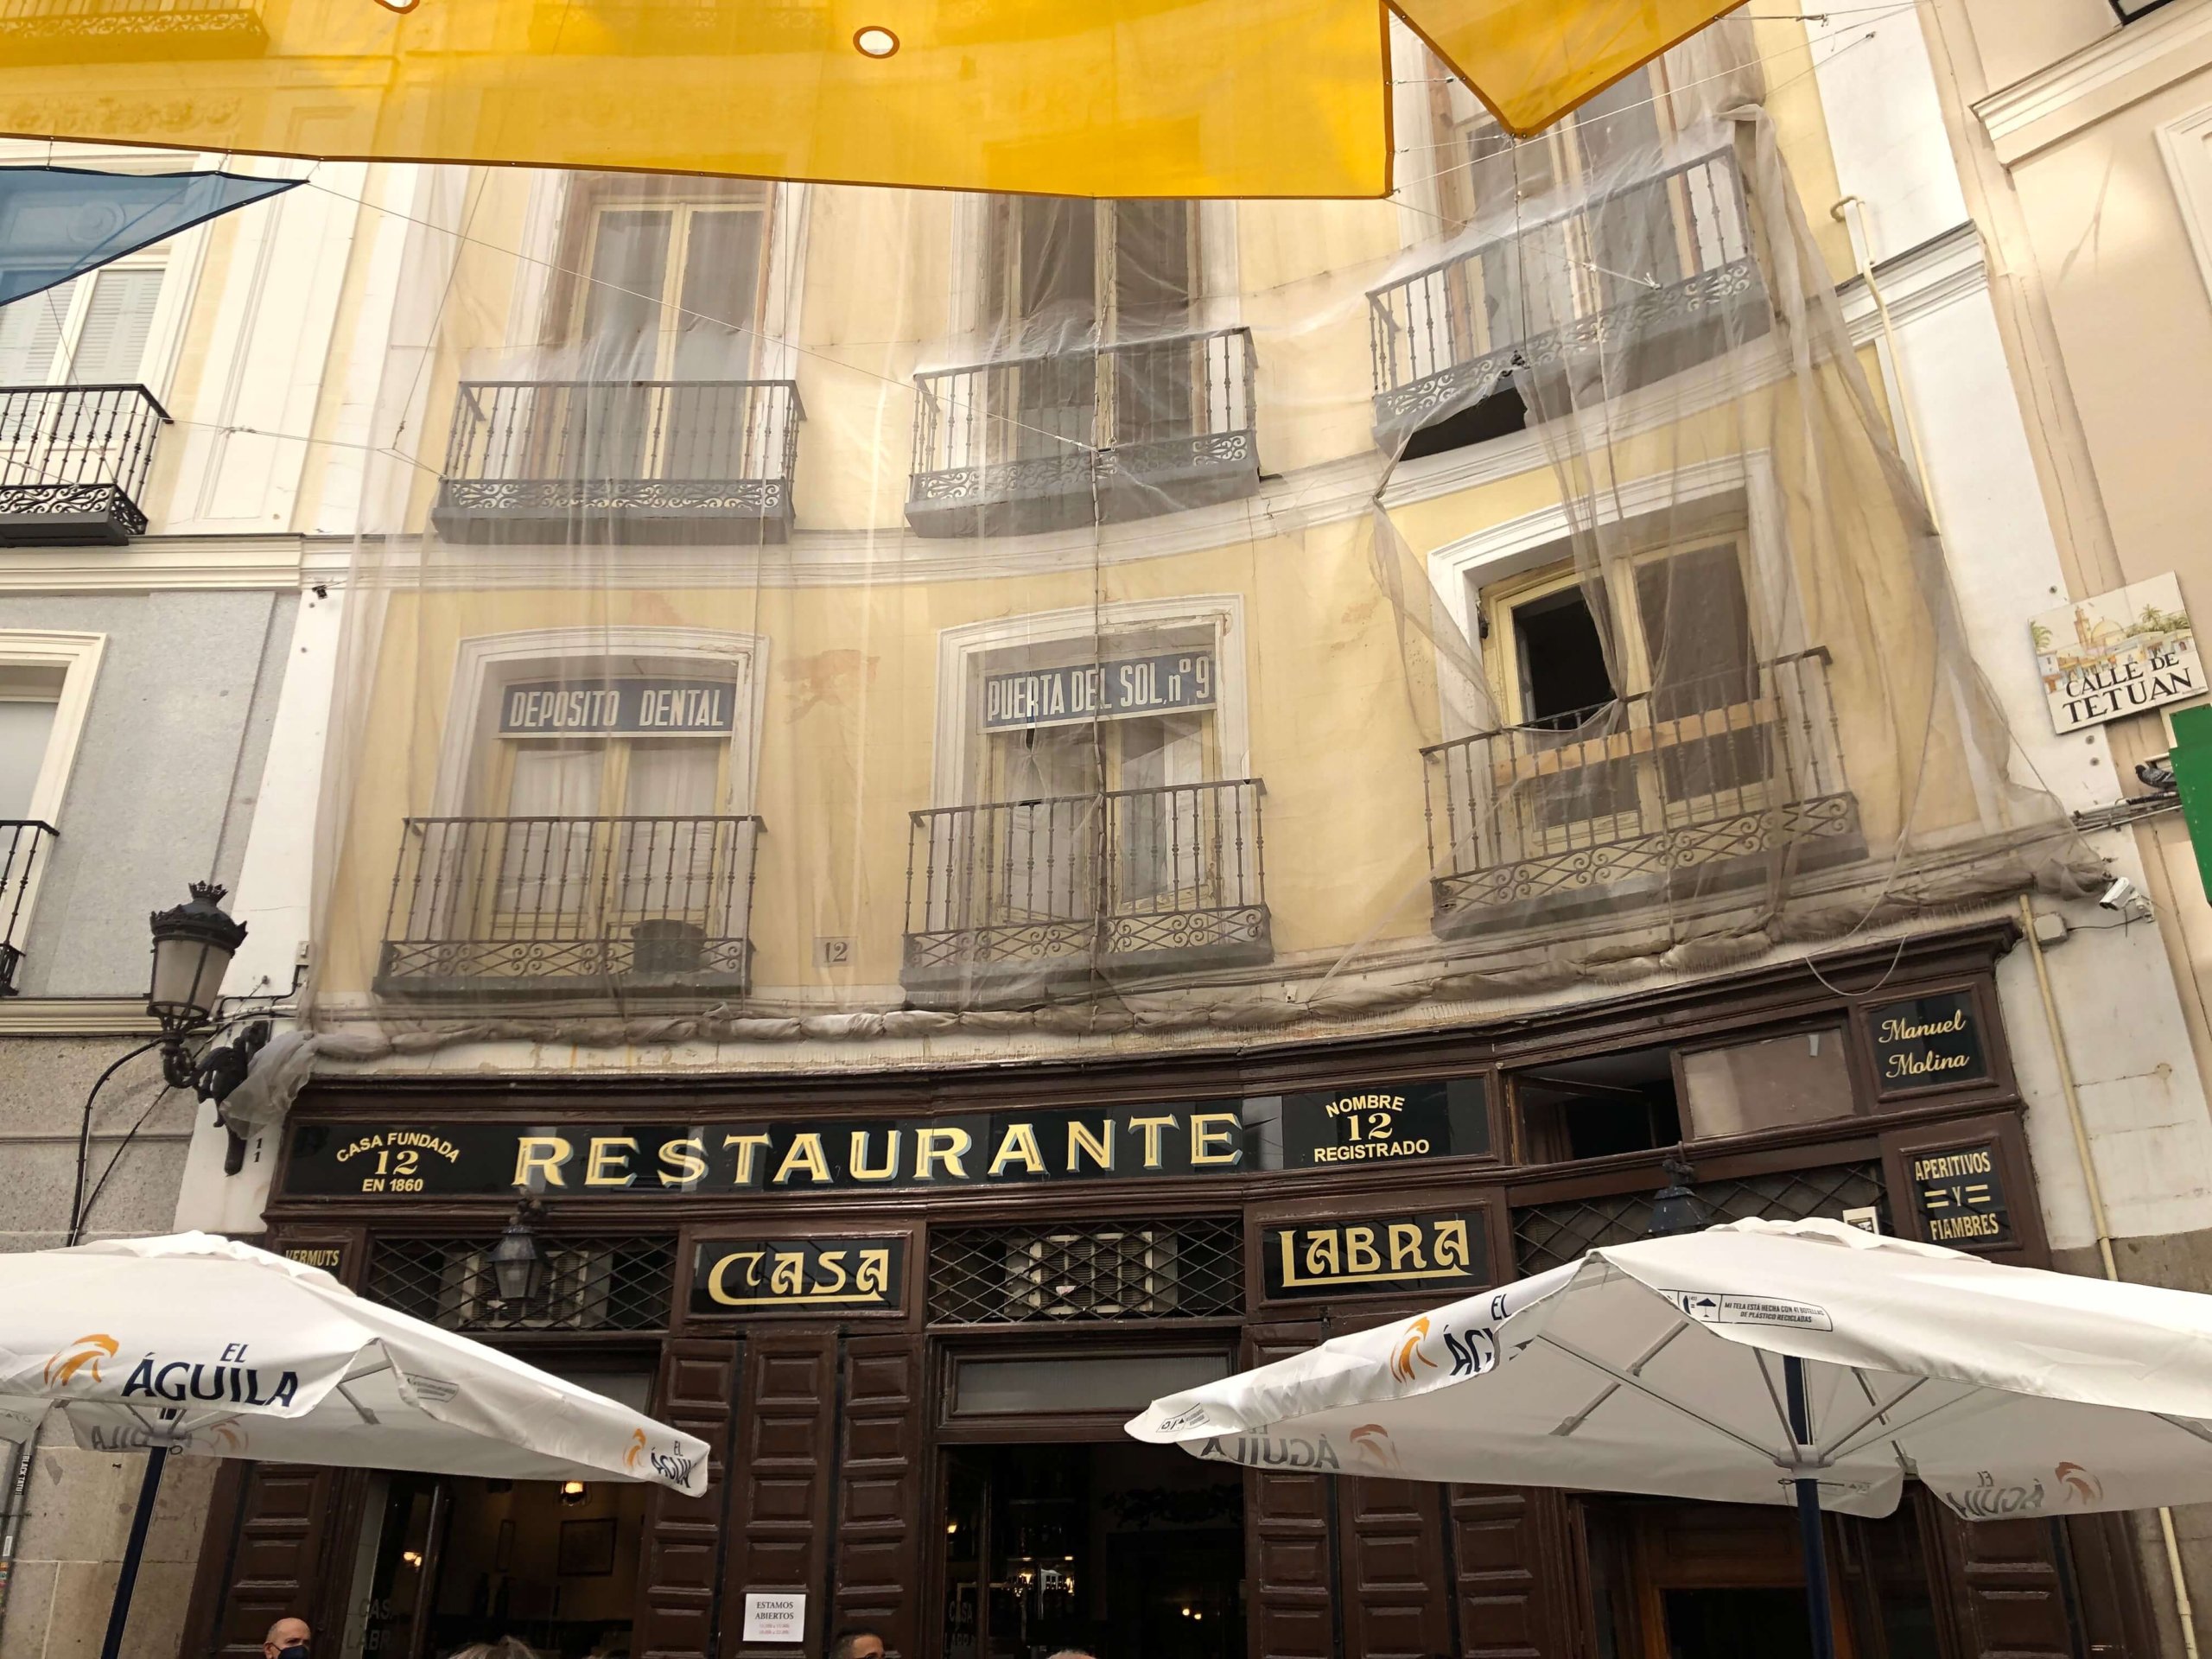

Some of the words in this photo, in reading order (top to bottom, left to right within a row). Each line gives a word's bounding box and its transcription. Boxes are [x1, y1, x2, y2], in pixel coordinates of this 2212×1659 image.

[2066, 661, 2144, 698] CALLE
[2148, 652, 2180, 672] DE
[509, 690, 620, 728] DEPOSITO
[639, 690, 724, 727] DENTAL
[987, 672, 1065, 721] PUERTA
[1071, 668, 1112, 713] DEL
[2062, 667, 2194, 724] TETUAN
[823, 941, 848, 963] 12
[1878, 1008, 1967, 1044] Manuel
[1885, 1050, 1970, 1078] Molina
[1325, 1094, 1406, 1119] NOMBRE
[1347, 1112, 1393, 1141] 12
[336, 1135, 384, 1163] CASA
[386, 1132, 461, 1164] FUNDADA
[511, 1112, 1243, 1189] RESTAURANTE
[1313, 1138, 1430, 1163] REGISTRADO
[374, 1150, 419, 1176] 12
[1914, 1151, 1992, 1182] APERITIVOS
[361, 1178, 385, 1192] EN
[389, 1178, 424, 1192] 1860
[1951, 1185, 1963, 1207] Y
[1929, 1212, 1999, 1242] FIAMBRES
[1278, 1219, 1475, 1287] LABRA
[708, 1249, 889, 1306] CASA
[1491, 1293, 1513, 1321] EL
[219, 1343, 249, 1363] EL
[120, 1351, 299, 1408] ÁGUILA
[754, 1611, 794, 1620] ABIERTOS
[756, 1600, 794, 1610] ESTAMOS
